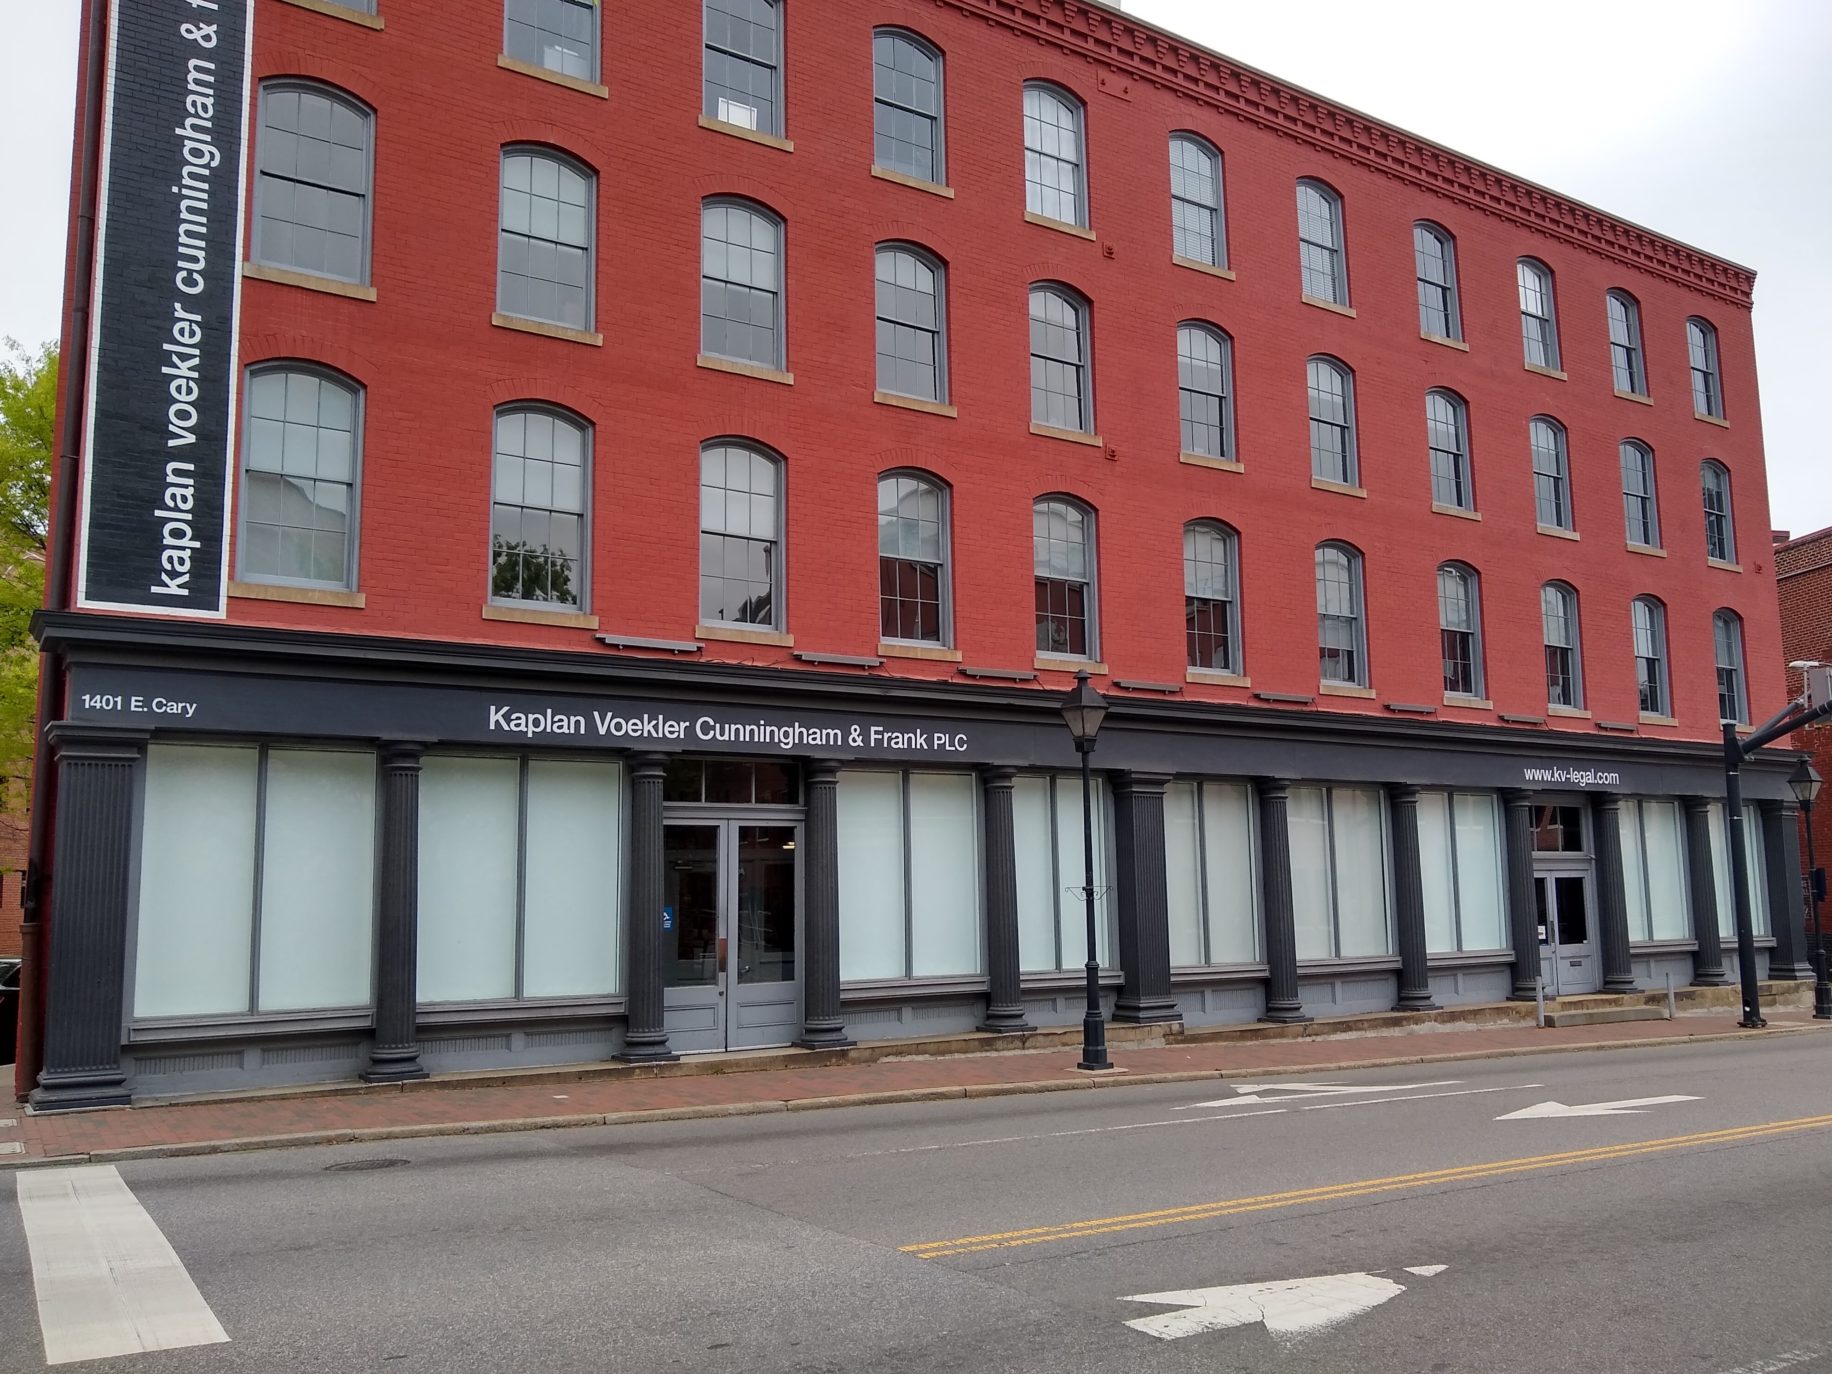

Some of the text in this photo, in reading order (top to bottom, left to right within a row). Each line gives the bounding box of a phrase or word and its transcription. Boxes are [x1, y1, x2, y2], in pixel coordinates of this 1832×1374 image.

[180, 22, 218, 49] &
[171, 58, 221, 295] cunningham
[161, 301, 202, 447] voekler
[150, 461, 201, 596] kaplan
[81, 693, 197, 718] 1401 E. Cary
[489, 705, 968, 752] Kaplan Voekler Cunningham & Frank PLC
[1523, 766, 1620, 787] www.kv-legal.com
